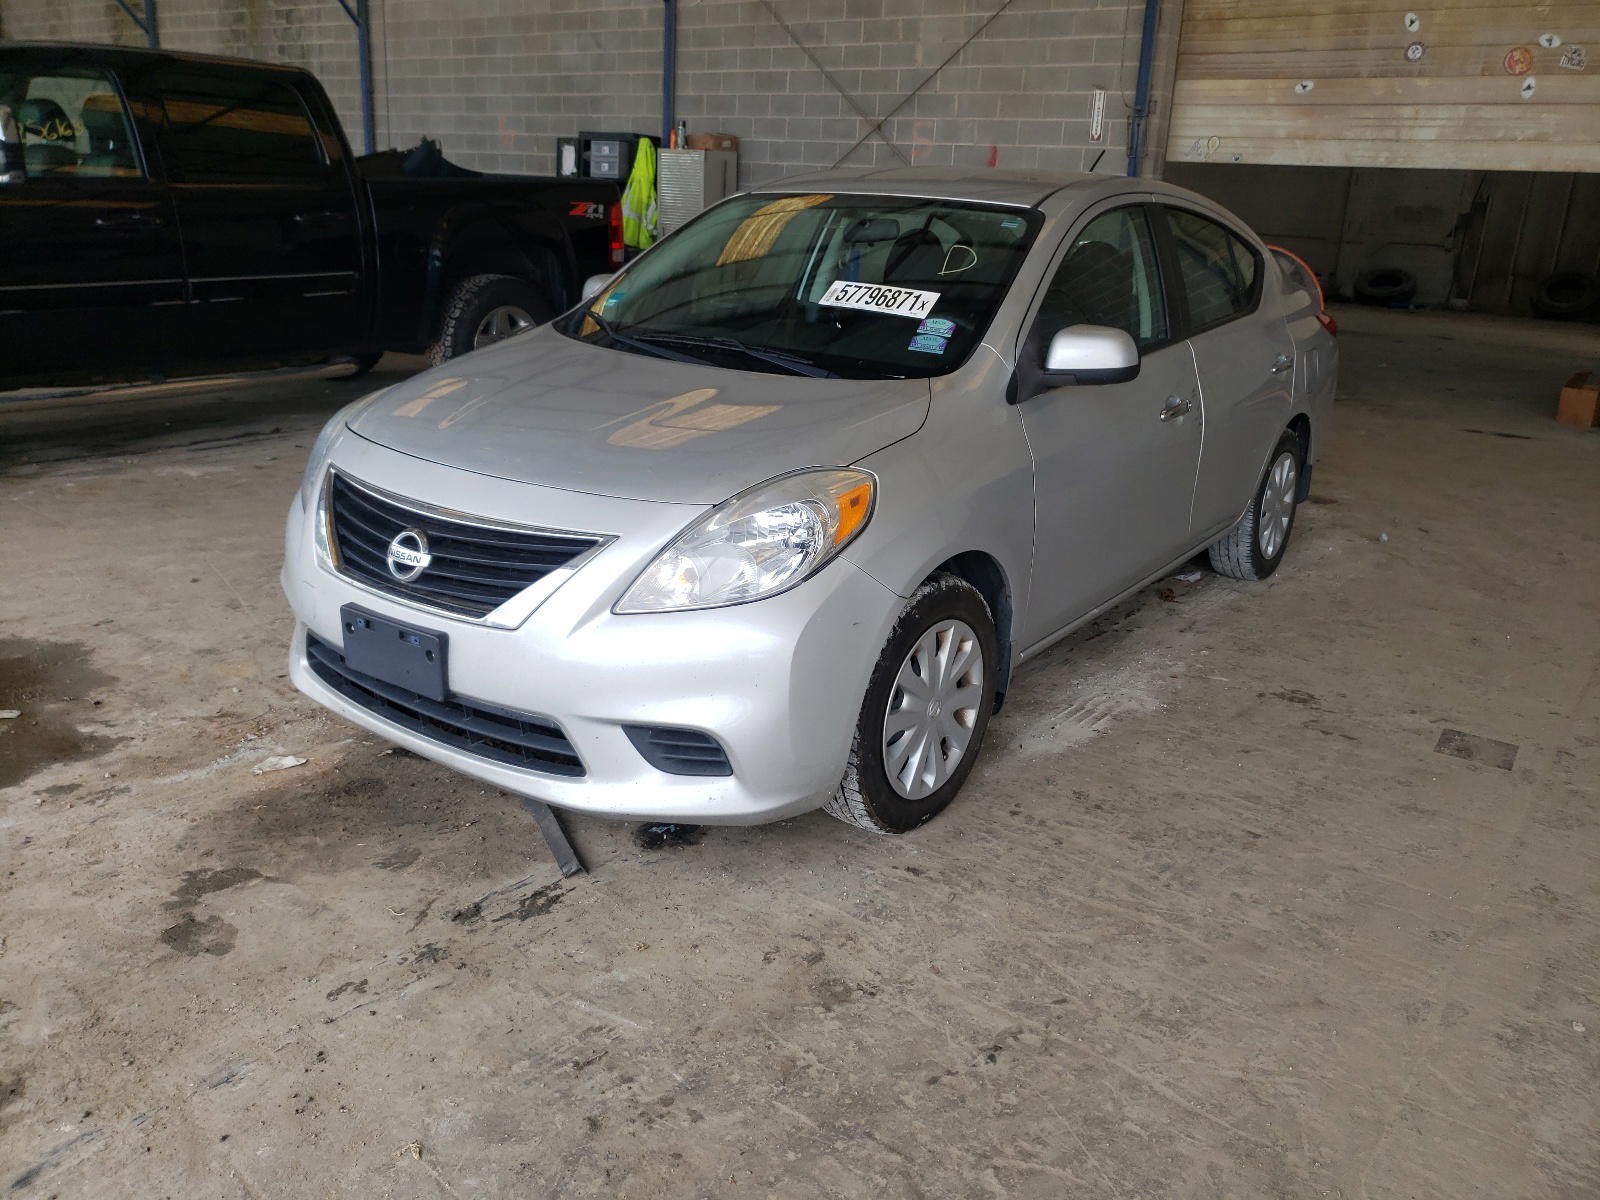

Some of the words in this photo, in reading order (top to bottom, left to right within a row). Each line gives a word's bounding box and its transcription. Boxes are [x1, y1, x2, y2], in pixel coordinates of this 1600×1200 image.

[568, 200, 604, 216] Z71
[936, 244, 978, 276] D
[388, 548, 422, 565] NISSAN
